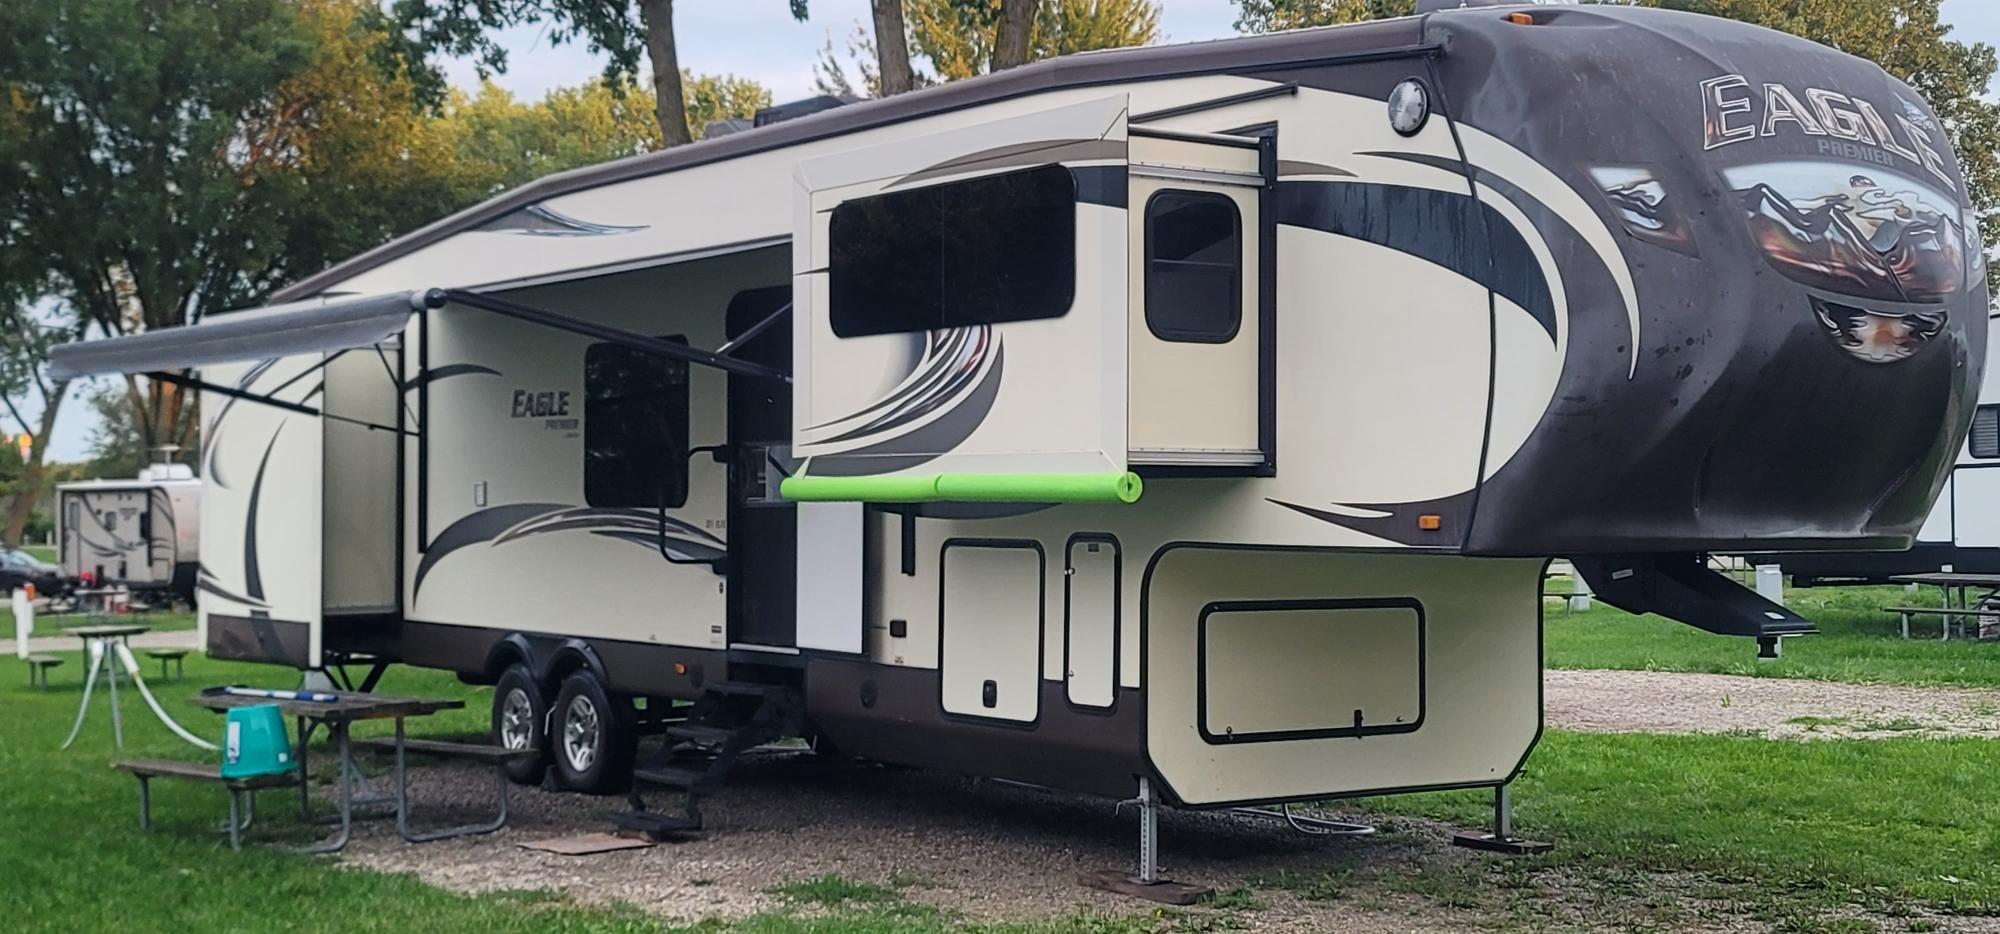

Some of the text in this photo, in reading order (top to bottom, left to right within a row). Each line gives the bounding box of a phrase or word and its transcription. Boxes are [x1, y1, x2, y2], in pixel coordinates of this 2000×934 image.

[1700, 74, 1957, 193] EAGLE
[1817, 138, 1894, 167] PREMIER
[511, 389, 570, 418] EAGLE
